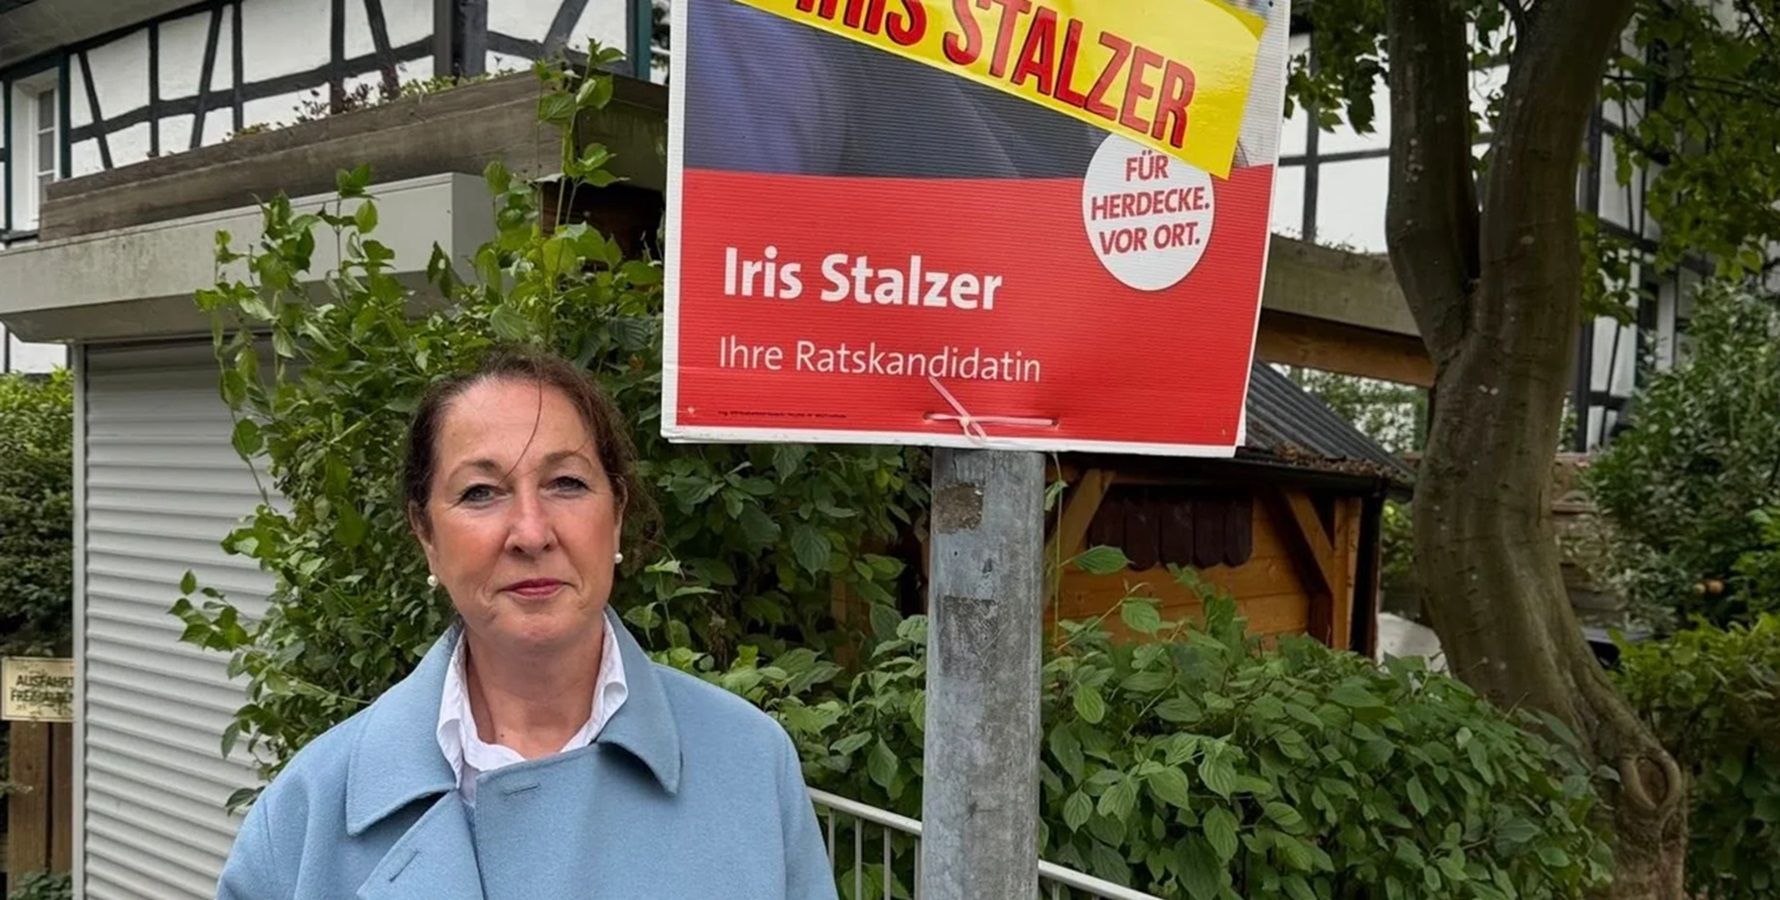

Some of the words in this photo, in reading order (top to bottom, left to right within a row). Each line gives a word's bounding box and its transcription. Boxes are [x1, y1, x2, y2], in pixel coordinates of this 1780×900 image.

[942, 0, 1196, 148] STALZER
[1125, 150, 1169, 181] FÜR
[1091, 187, 1210, 220] HERDECKE.
[1099, 228, 1147, 255] VOR
[1153, 222, 1200, 249] ORT.
[724, 246, 803, 299] Iris
[820, 254, 1003, 310] Stalzer
[719, 335, 783, 370] Ihre
[796, 340, 1041, 382] Ratskandidatin
